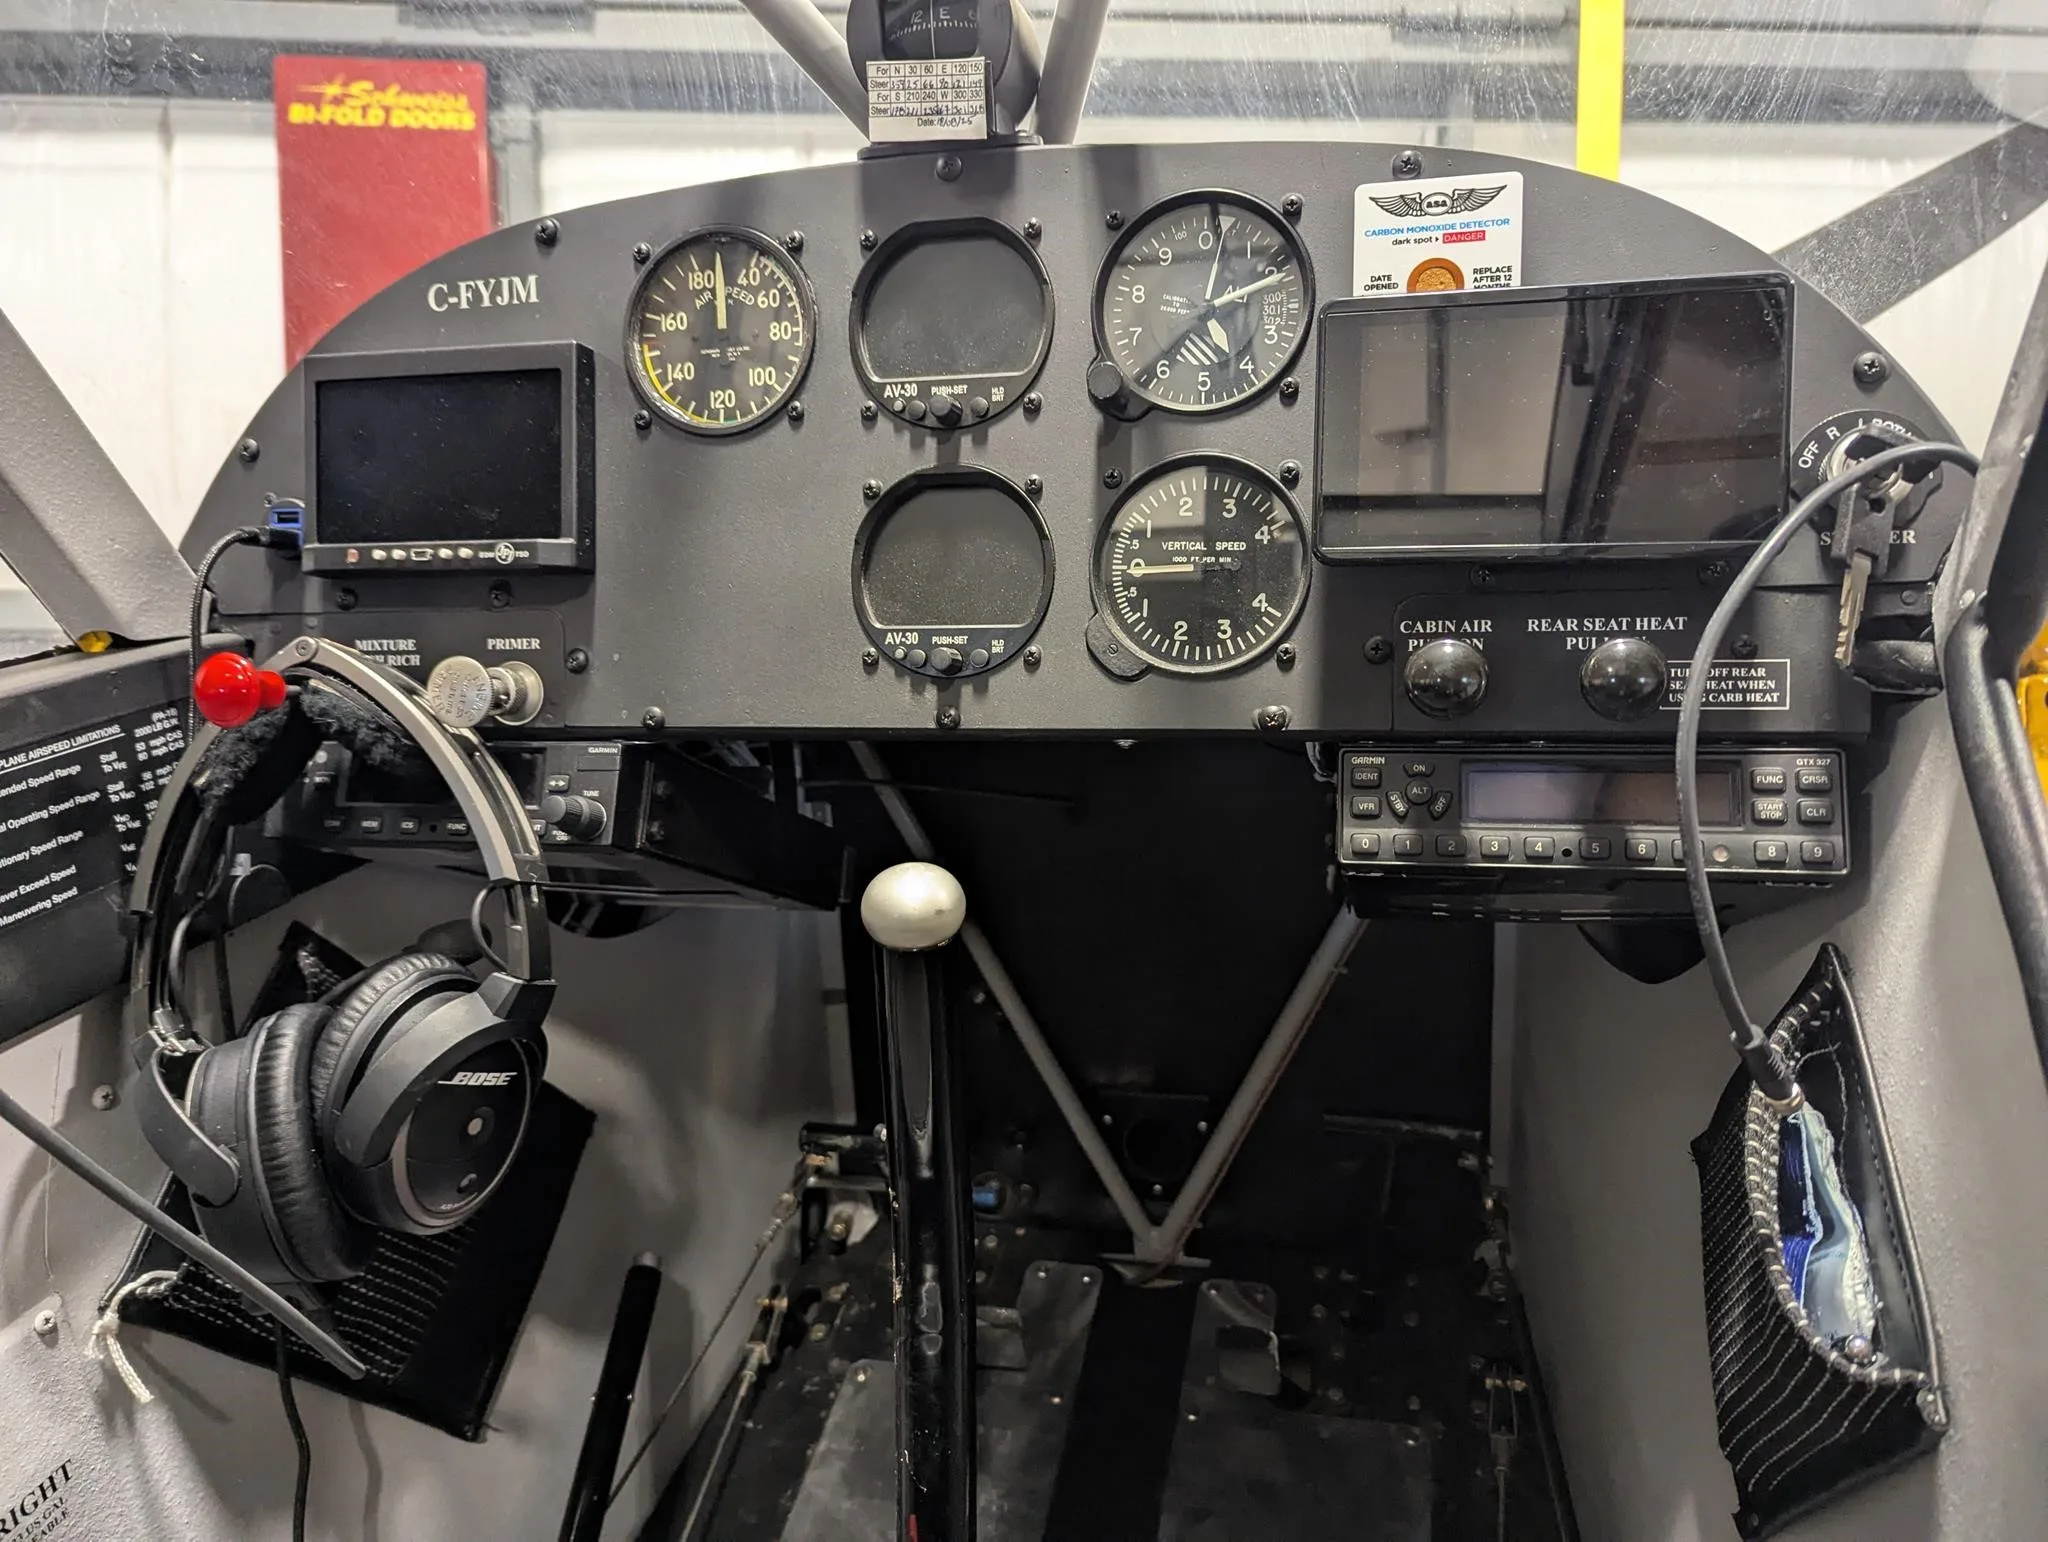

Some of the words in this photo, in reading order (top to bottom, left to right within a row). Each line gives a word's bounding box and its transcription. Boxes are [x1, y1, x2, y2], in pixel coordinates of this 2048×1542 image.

[940, 6, 950, 19] E
[876, 66, 889, 75] For
[894, 66, 901, 75] N
[908, 66, 918, 74] 30
[924, 65, 933, 74] 60
[942, 65, 947, 74] E
[954, 64, 967, 73] 120
[870, 79, 888, 89] Steer
[877, 92, 889, 101] For
[895, 92, 901, 101] S
[907, 92, 920, 101] 210
[922, 91, 936, 101] 240
[940, 91, 949, 100] W
[954, 90, 967, 99] 300
[969, 89, 983, 98] 330
[389, 109, 476, 131] DOORS
[870, 106, 889, 115] Steer
[1364, 224, 1406, 238] CARBON
[1406, 221, 1457, 234] MONOXIDE
[1460, 218, 1510, 230] DETECTOR
[1198, 231, 1213, 250] 0
[1392, 236, 1411, 246] dark
[1413, 235, 1433, 245] spot
[1444, 232, 1484, 243] DANGER
[1158, 247, 1172, 266] 9
[737, 267, 760, 287] 40
[1370, 274, 1392, 283] DATE
[1472, 265, 1513, 275] REPLACE
[1472, 275, 1501, 284] AFTER
[1503, 274, 1512, 282] 12
[688, 271, 715, 291] 180
[1363, 282, 1399, 292] OPENED
[427, 274, 540, 312] C-FYJM
[695, 291, 714, 310] AIR
[724, 286, 755, 306] PEED
[757, 289, 780, 308] 60
[1131, 285, 1146, 304] 8
[661, 311, 688, 332] 160
[769, 321, 792, 340] 80
[1129, 327, 1143, 346] 7
[1264, 325, 1278, 344] 3
[667, 362, 695, 381] 140
[1156, 360, 1170, 379] 6
[1239, 355, 1254, 374] 4
[749, 367, 776, 386] 100
[1198, 371, 1211, 391] 5
[710, 389, 736, 409] 120
[884, 383, 918, 398] AV-30
[931, 385, 968, 395] PUSH-SET
[1826, 426, 1840, 440] R
[1798, 440, 1819, 469] OFF
[1179, 497, 1193, 517] 2
[1222, 498, 1237, 518] 3
[1254, 525, 1271, 545] 4
[1161, 541, 1207, 551] VERTICAL
[1215, 541, 1247, 551] SPEED
[1252, 593, 1268, 613] 4
[1174, 621, 1188, 640] 2
[1217, 619, 1232, 639] 3
[1400, 620, 1456, 634] CABIN
[1460, 619, 1493, 633] AIR
[1527, 618, 1578, 632] REAR
[1583, 617, 1631, 631] SEAT
[1636, 616, 1688, 630] HEAT
[355, 639, 416, 651] MIXTURE
[486, 638, 541, 650] PRIMER
[885, 632, 919, 645] AV-30
[932, 636, 968, 644] PUSH-SET
[388, 655, 421, 666] RICH
[1732, 667, 1767, 677] REAR
[1737, 680, 1776, 689] WHEN
[1708, 693, 1743, 702] CARB
[1746, 692, 1780, 702] HEAT
[28, 740, 70, 760] AIRSPEED
[70, 724, 121, 746] LIMITATIONS
[1351, 757, 1385, 765] GARMIN
[27, 771, 55, 787] Speed
[54, 764, 81, 778] Range
[1355, 773, 1378, 781] IDENT
[1756, 776, 1783, 784] FUNC
[1802, 776, 1828, 784] CRSR
[7, 809, 48, 828] Operating
[48, 798, 75, 814] Speed
[75, 791, 100, 805] Range
[1358, 802, 1375, 810] VFR
[1390, 794, 1406, 813] STBY
[1435, 797, 1447, 812] OFF
[1758, 803, 1783, 811] START
[1806, 808, 1826, 817] CLR
[1760, 811, 1782, 819] STOP
[30, 838, 57, 855] Speed
[57, 830, 84, 845] Range
[1362, 839, 1369, 848] 0
[1405, 840, 1410, 849] 1
[1448, 841, 1456, 851] 2
[1490, 841, 1498, 851] 3
[1534, 842, 1542, 852] 4
[1591, 843, 1600, 853] 5
[1638, 844, 1646, 854] 6
[1768, 846, 1776, 857] 8
[1814, 847, 1822, 857] 9
[19, 875, 50, 894] Exceed
[50, 864, 77, 881] Speed
[0, 899, 52, 926] Maneuvering
[52, 886, 78, 904] Speed
[437, 1071, 518, 1086] BOSE
